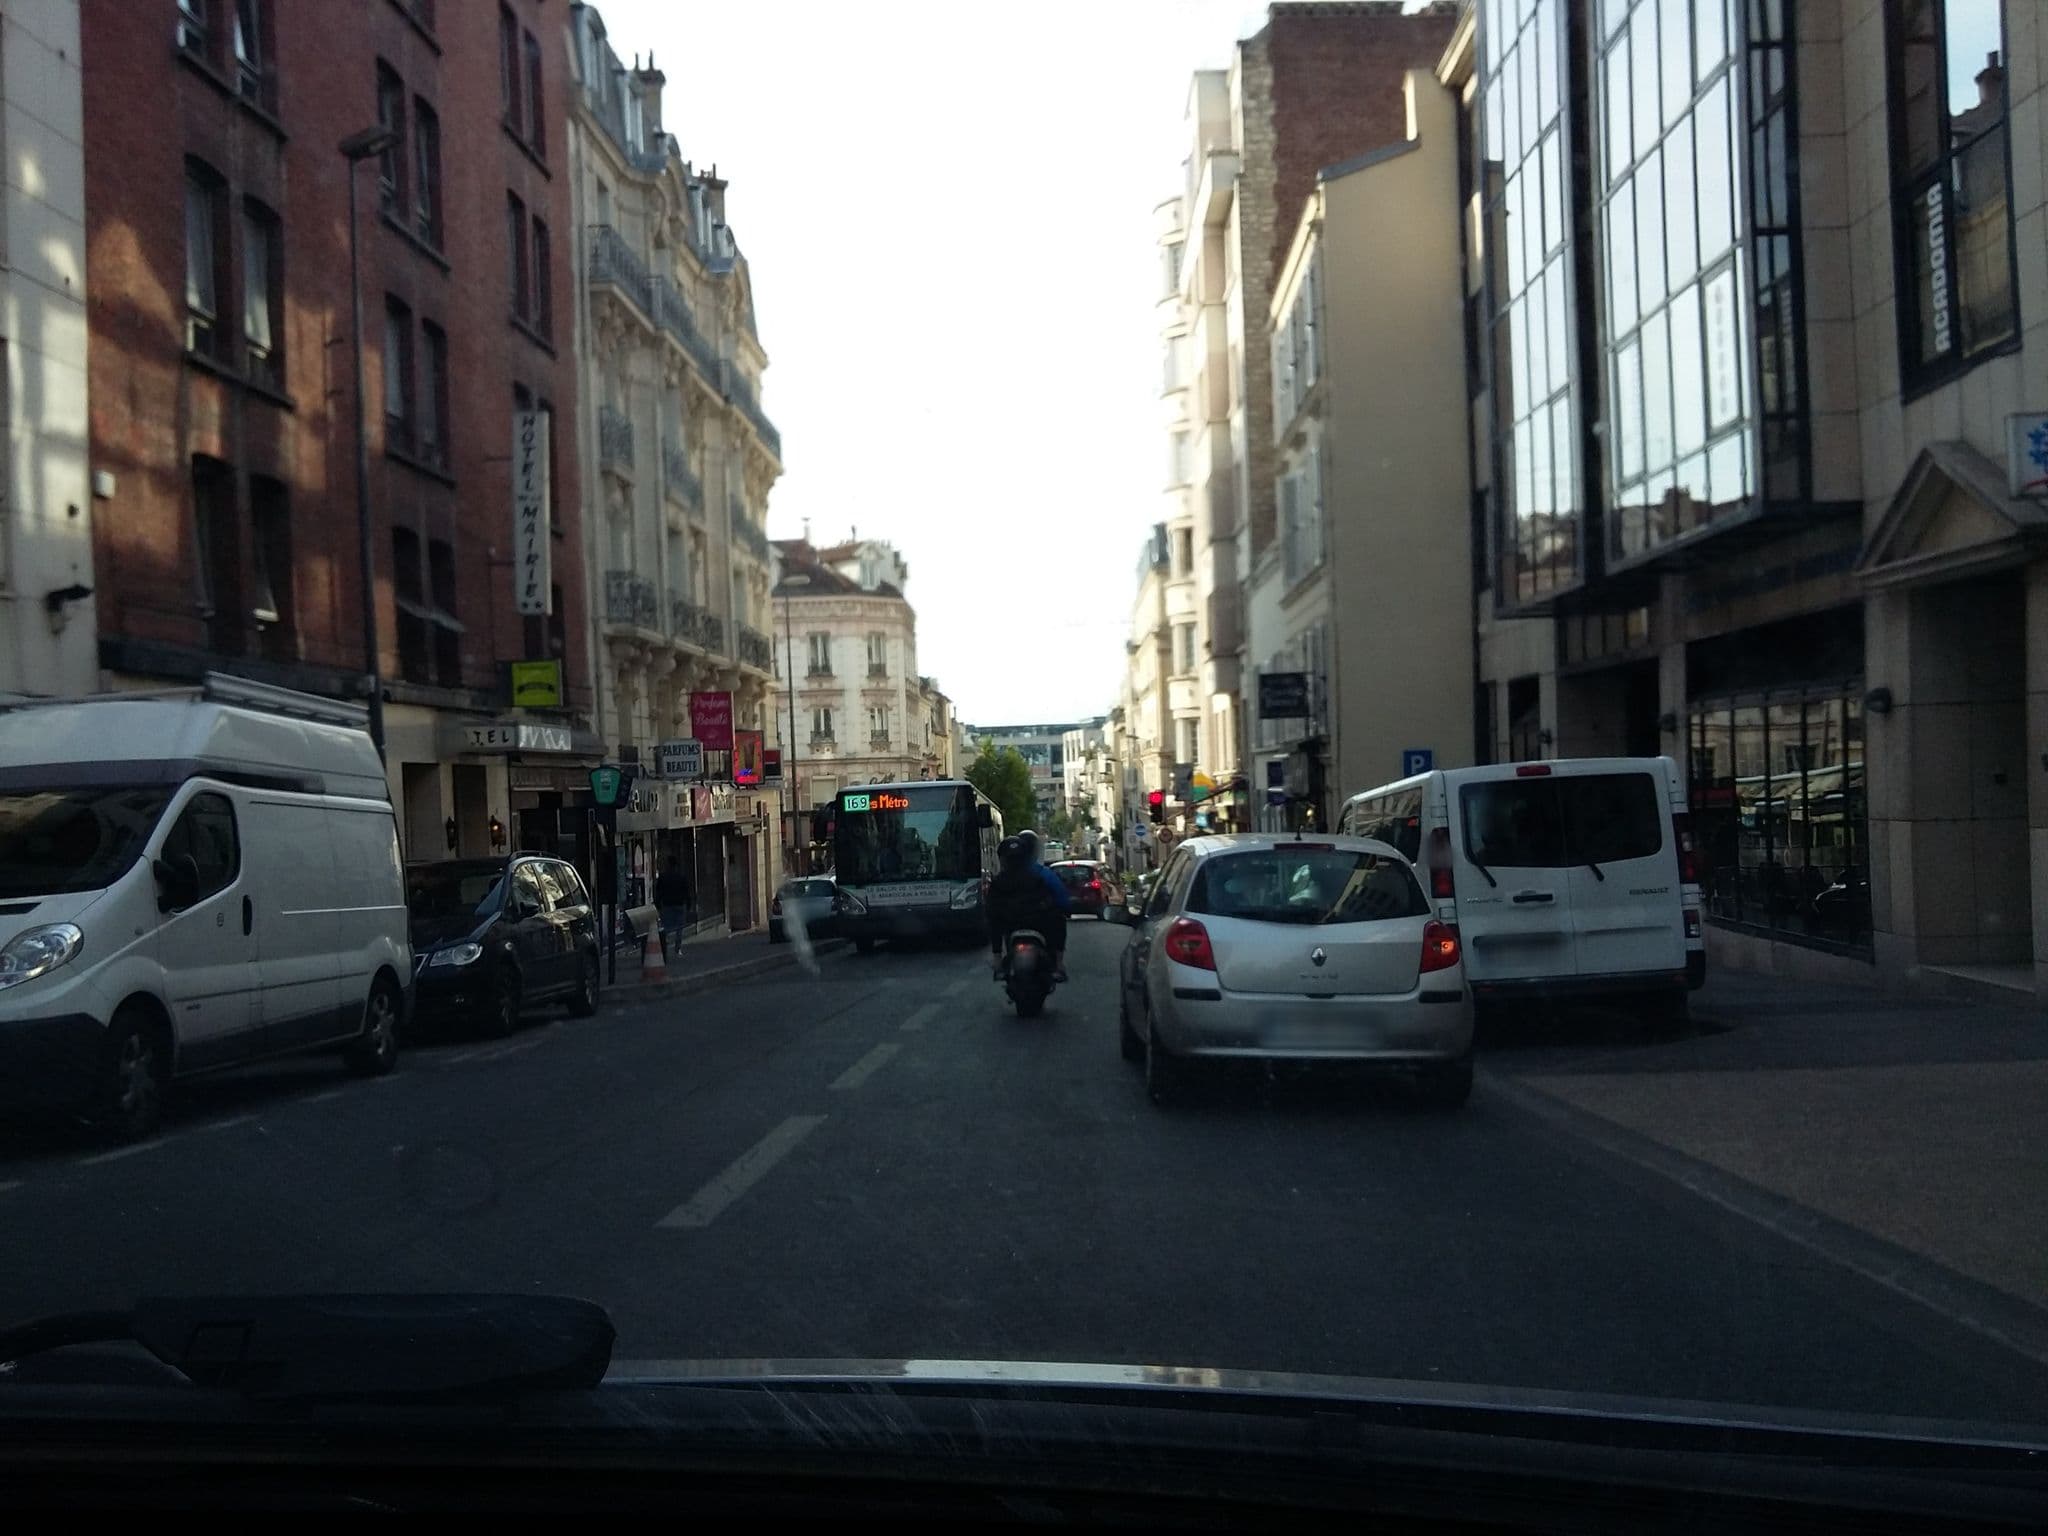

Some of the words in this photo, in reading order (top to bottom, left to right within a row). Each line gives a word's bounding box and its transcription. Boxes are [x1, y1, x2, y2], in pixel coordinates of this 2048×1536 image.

[1927, 181, 1951, 352] ACADOMIA
[521, 505, 539, 598] MAIRIE
[662, 743, 700, 757] PARFUMS
[1410, 754, 1426, 773] P
[847, 796, 868, 809] 169
[879, 794, 909, 809] Métro
